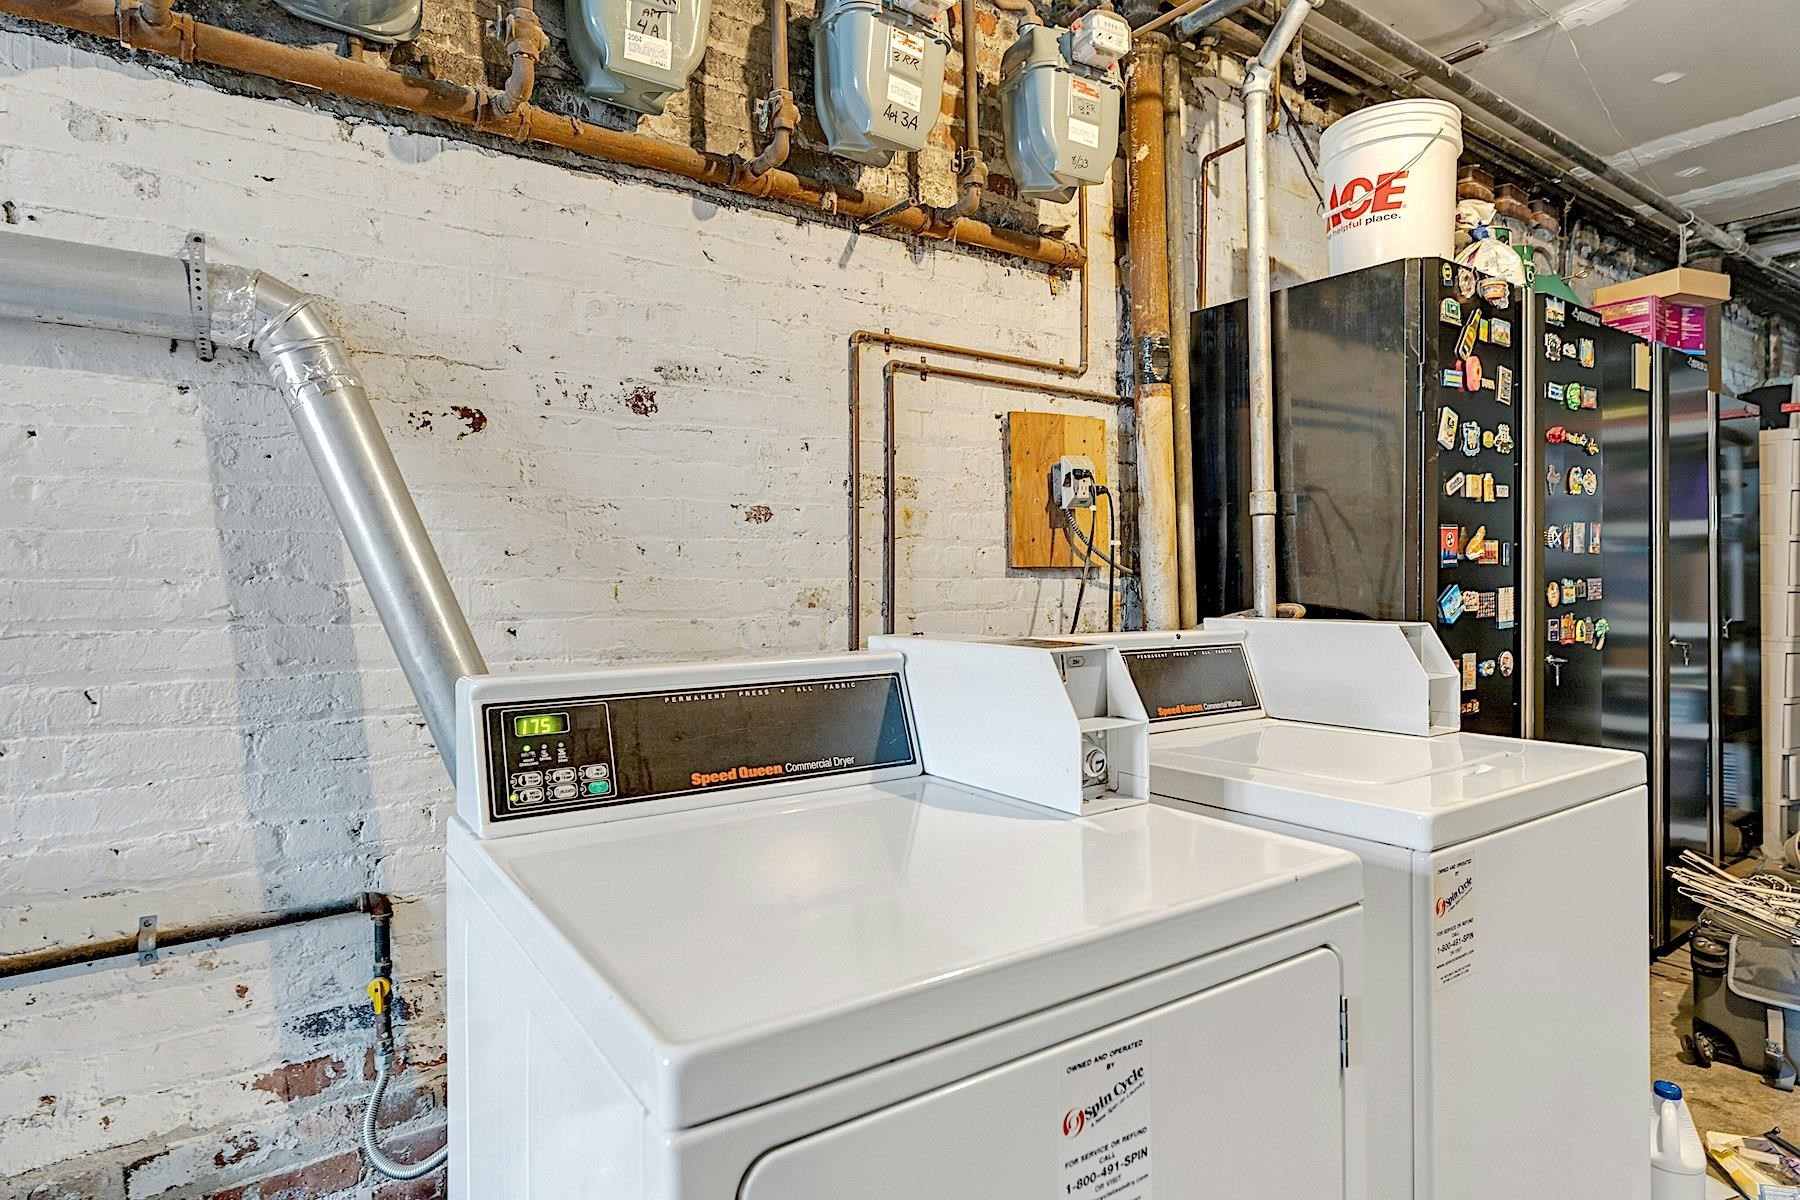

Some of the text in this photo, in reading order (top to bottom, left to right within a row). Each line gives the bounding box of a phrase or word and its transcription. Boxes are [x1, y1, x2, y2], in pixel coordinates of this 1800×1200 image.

[883, 103, 918, 131] Apt 3A
[1327, 170, 1409, 233] ACE
[1365, 212, 1402, 225] place.
[664, 682, 856, 703] PERMANENT PRESS ALL FABRIC
[1157, 704, 1180, 717] Speed
[1180, 703, 1203, 713] Queen
[1203, 701, 1227, 711] Commercial
[523, 717, 551, 735] 175
[690, 755, 855, 787] Speed Queen Commercial Dryer
[1066, 1039, 1143, 1074] OWNED AND OPERATED
[1106, 1062, 1115, 1070] BY
[1085, 1067, 1144, 1121] Spin Cycle
[1065, 1126, 1148, 1169] FOR SERVICE OR REFUND
[1099, 1152, 1115, 1164] CALL
[1066, 1147, 1148, 1194] 1-800-491-SPIN
[1094, 1183, 1105, 1192] OR
